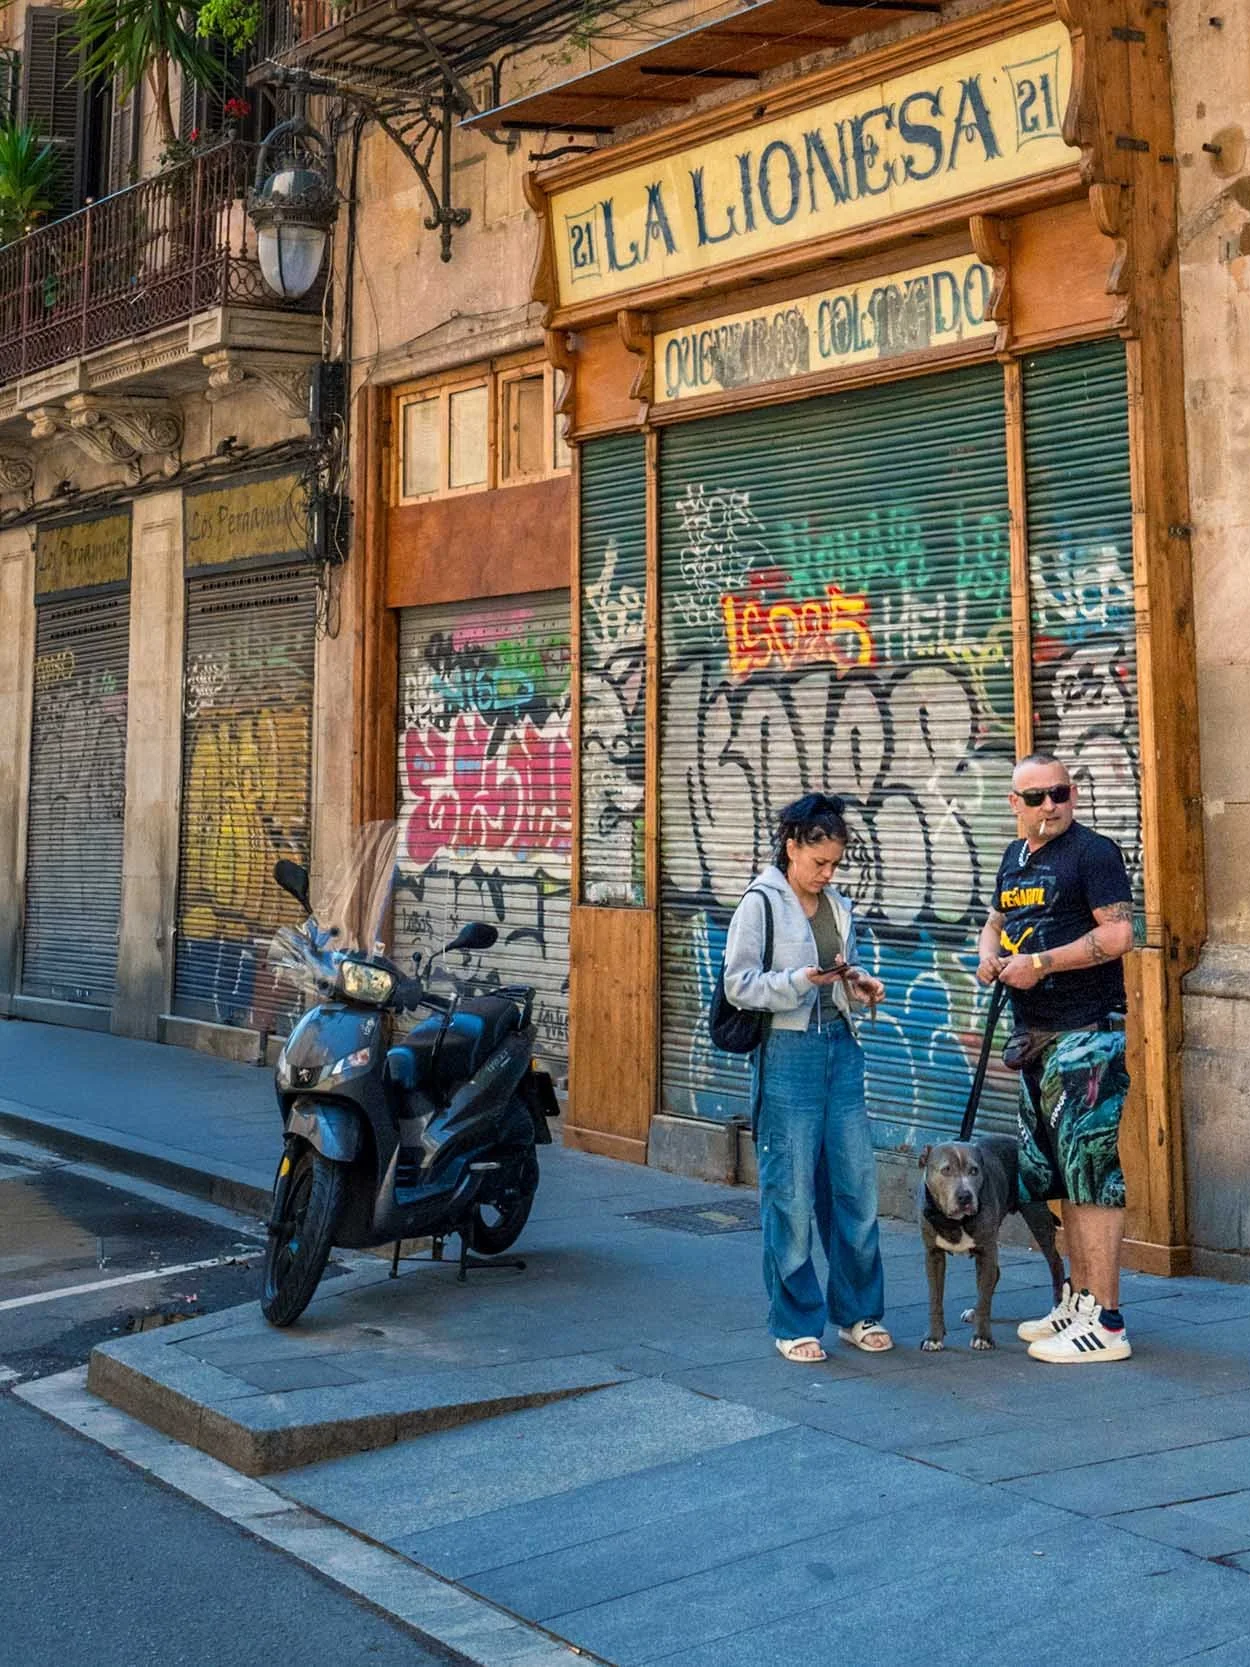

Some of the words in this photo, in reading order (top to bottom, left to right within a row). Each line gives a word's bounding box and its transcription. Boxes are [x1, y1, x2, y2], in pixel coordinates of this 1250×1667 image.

[571, 221, 595, 268] 21
[599, 180, 680, 273] LA
[690, 73, 1003, 247] LIONESA
[1016, 72, 1055, 133] 21
